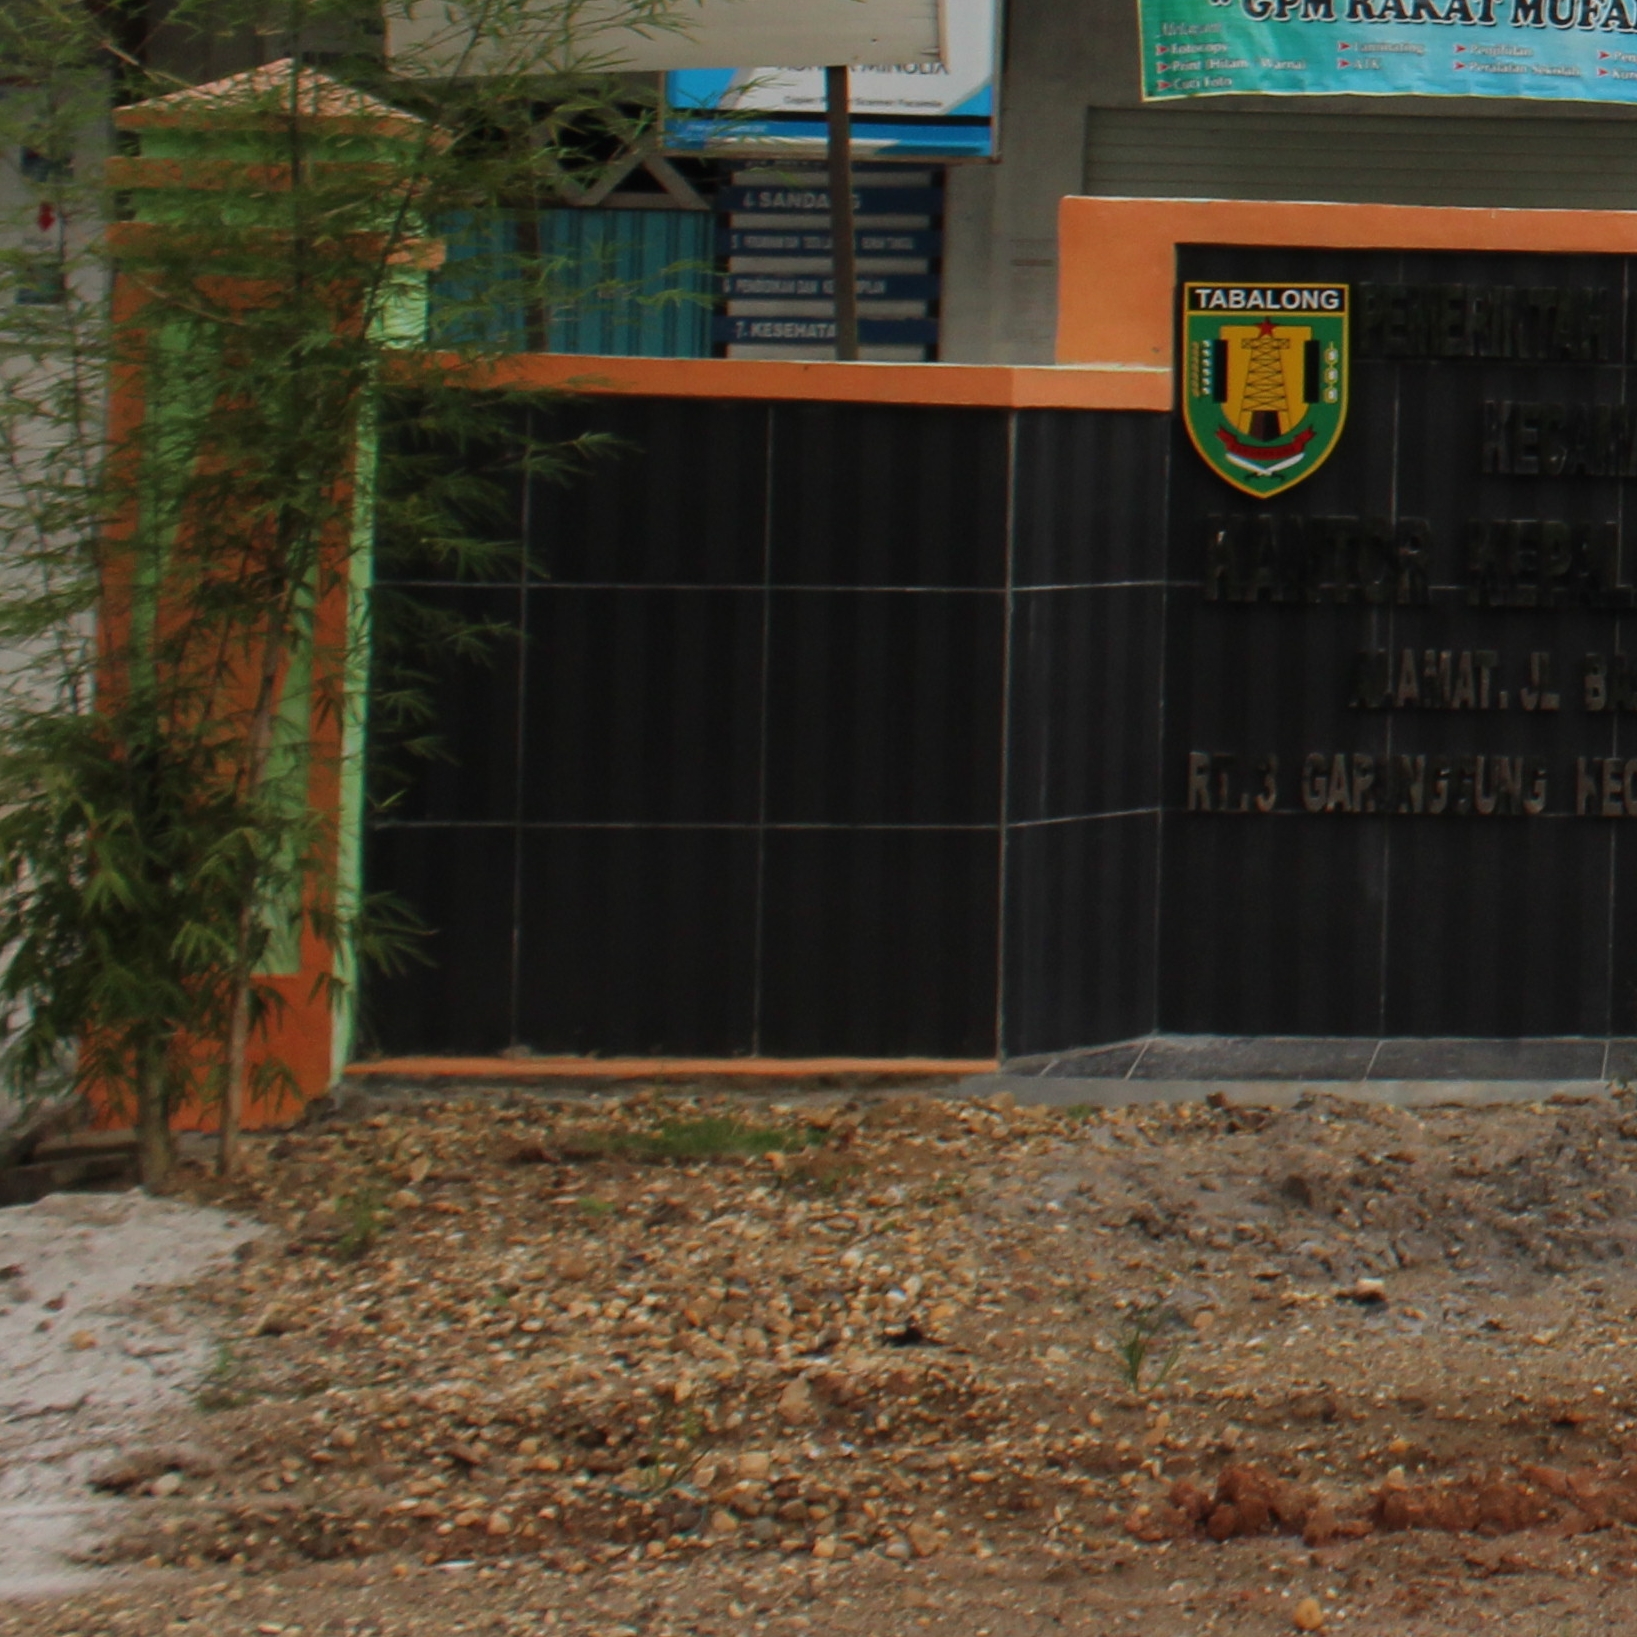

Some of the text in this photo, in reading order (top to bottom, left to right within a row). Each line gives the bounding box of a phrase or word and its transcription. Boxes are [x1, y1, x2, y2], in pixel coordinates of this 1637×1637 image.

[759, 192, 861, 209] SANDAG
[1195, 289, 1340, 309] TABALONG
[751, 323, 837, 339] KESEHATA
